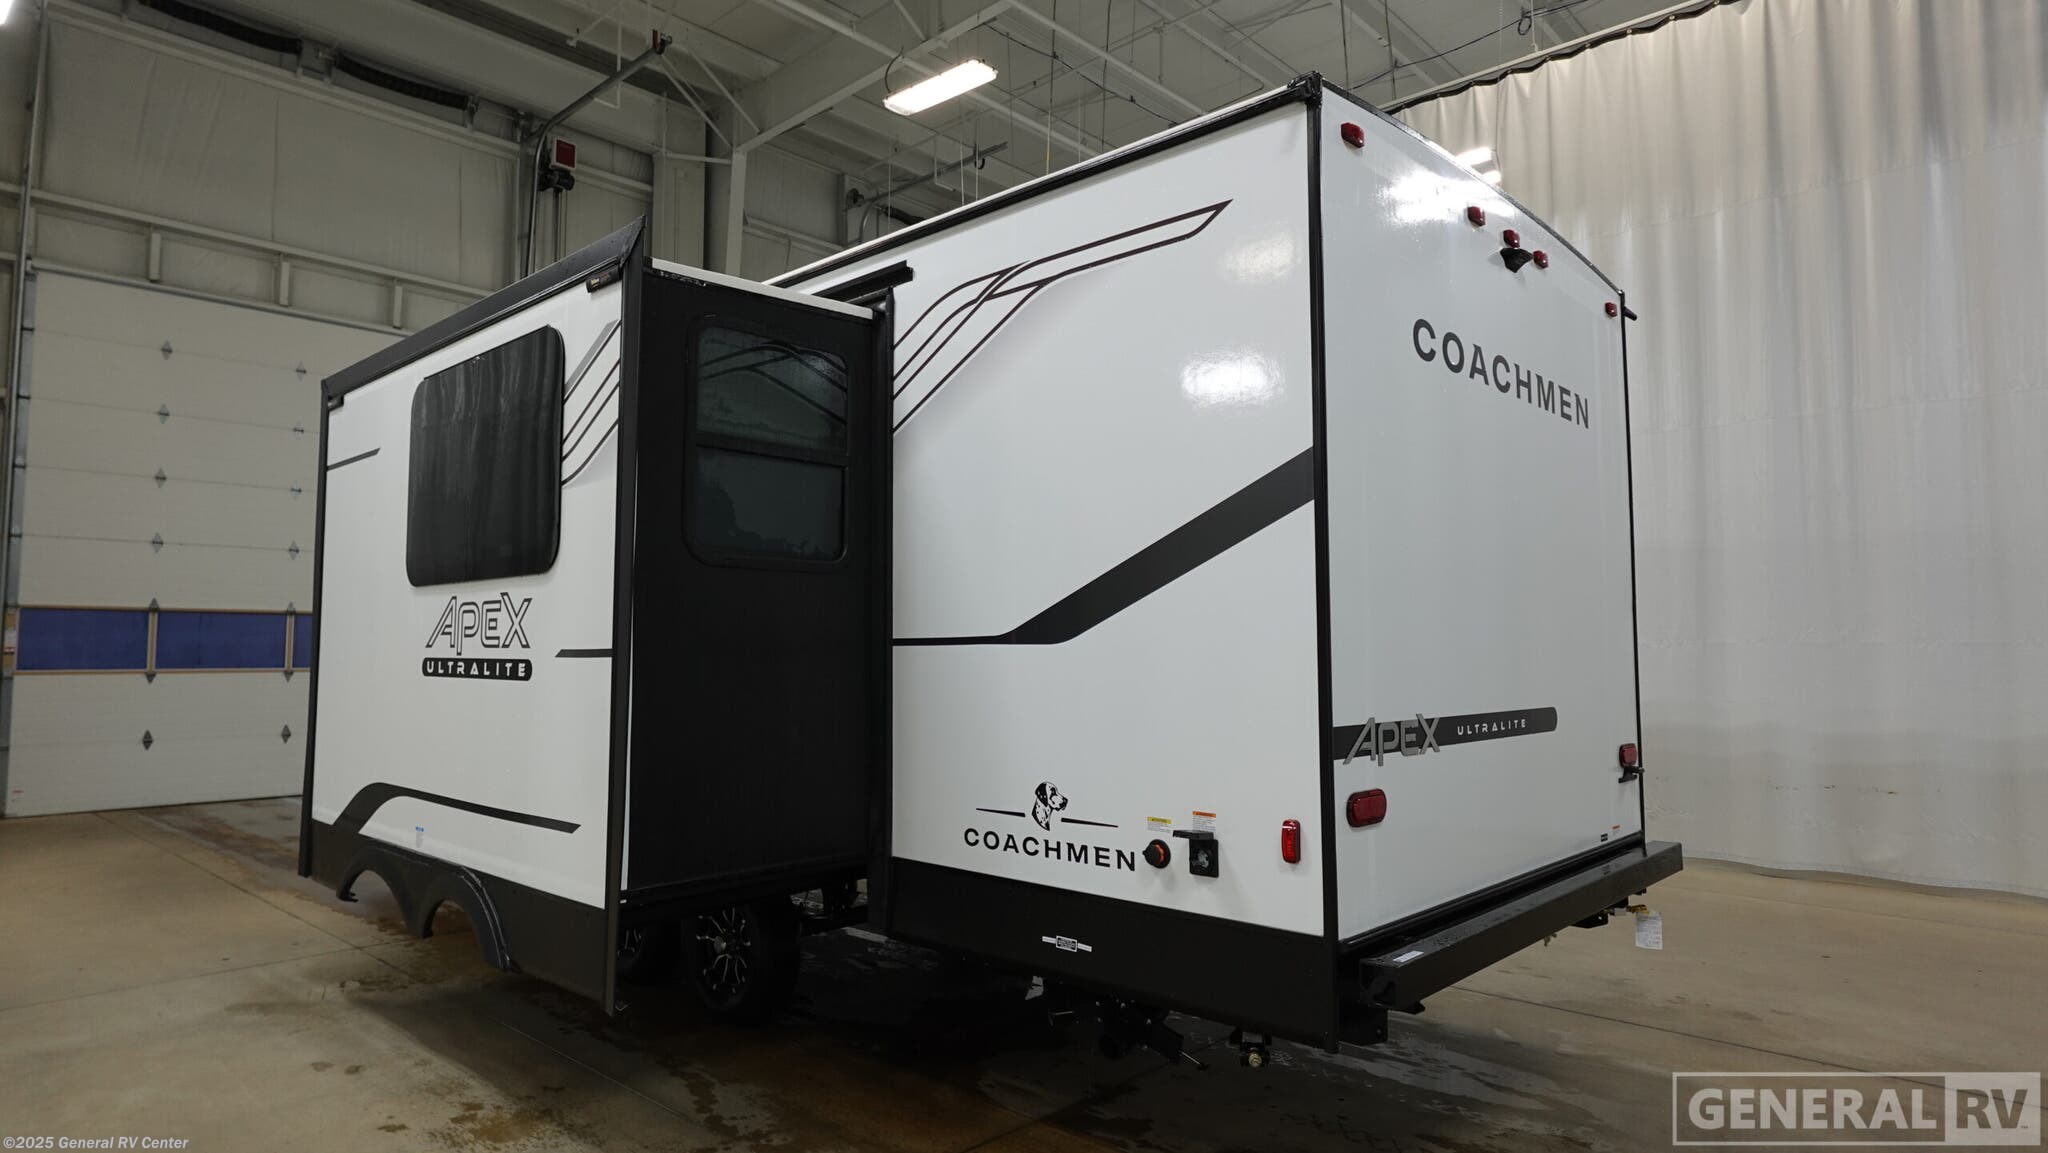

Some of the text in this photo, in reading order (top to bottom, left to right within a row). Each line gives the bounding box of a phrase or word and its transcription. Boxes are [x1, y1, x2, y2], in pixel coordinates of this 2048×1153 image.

[1413, 318, 1589, 429] COACHMEN
[425, 592, 533, 656] APEX
[426, 660, 526, 677] ULTRALITE
[1342, 713, 1526, 767] APEX ULTRALITE
[963, 827, 1136, 872] COACHMEN
